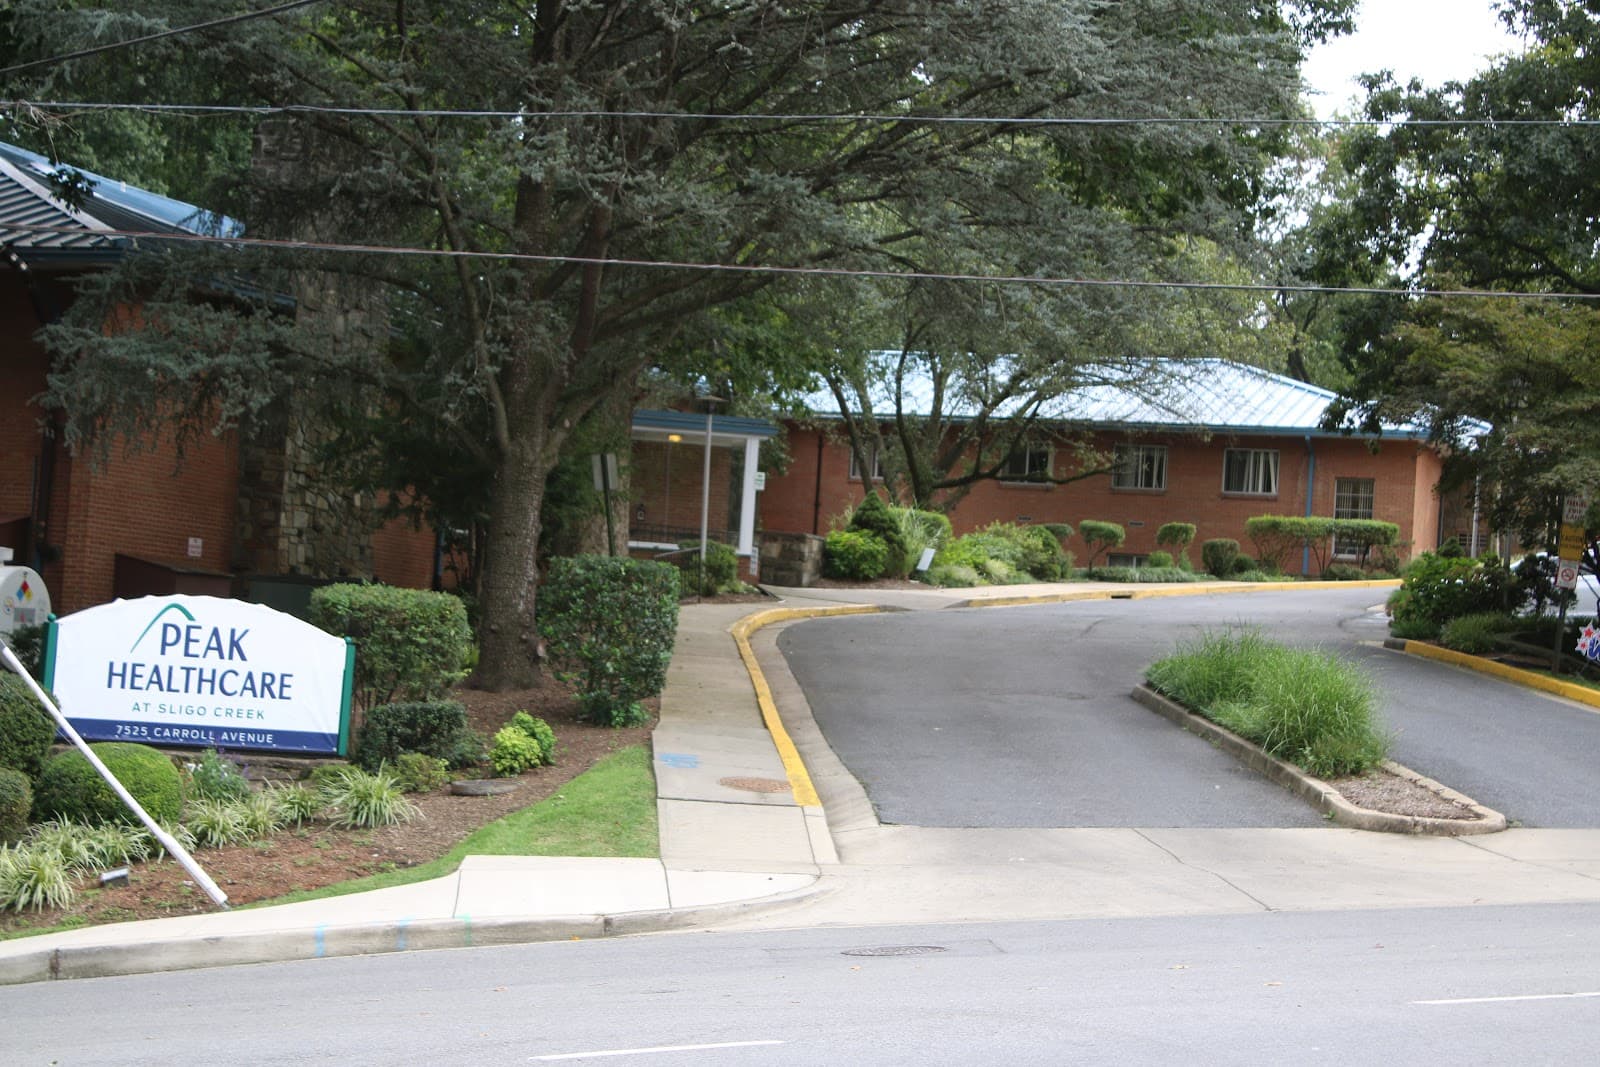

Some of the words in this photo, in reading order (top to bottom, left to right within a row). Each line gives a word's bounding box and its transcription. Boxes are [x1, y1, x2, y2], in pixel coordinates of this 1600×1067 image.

[160, 622, 250, 662] PEAK
[107, 661, 294, 700] HEALTHCARE
[132, 702, 152, 713] AT
[158, 703, 207, 717] SLIGO
[213, 706, 265, 720] CREEK
[116, 724, 148, 737] 7525
[153, 727, 216, 741] CARROLL
[221, 731, 273, 744] AVENUE
